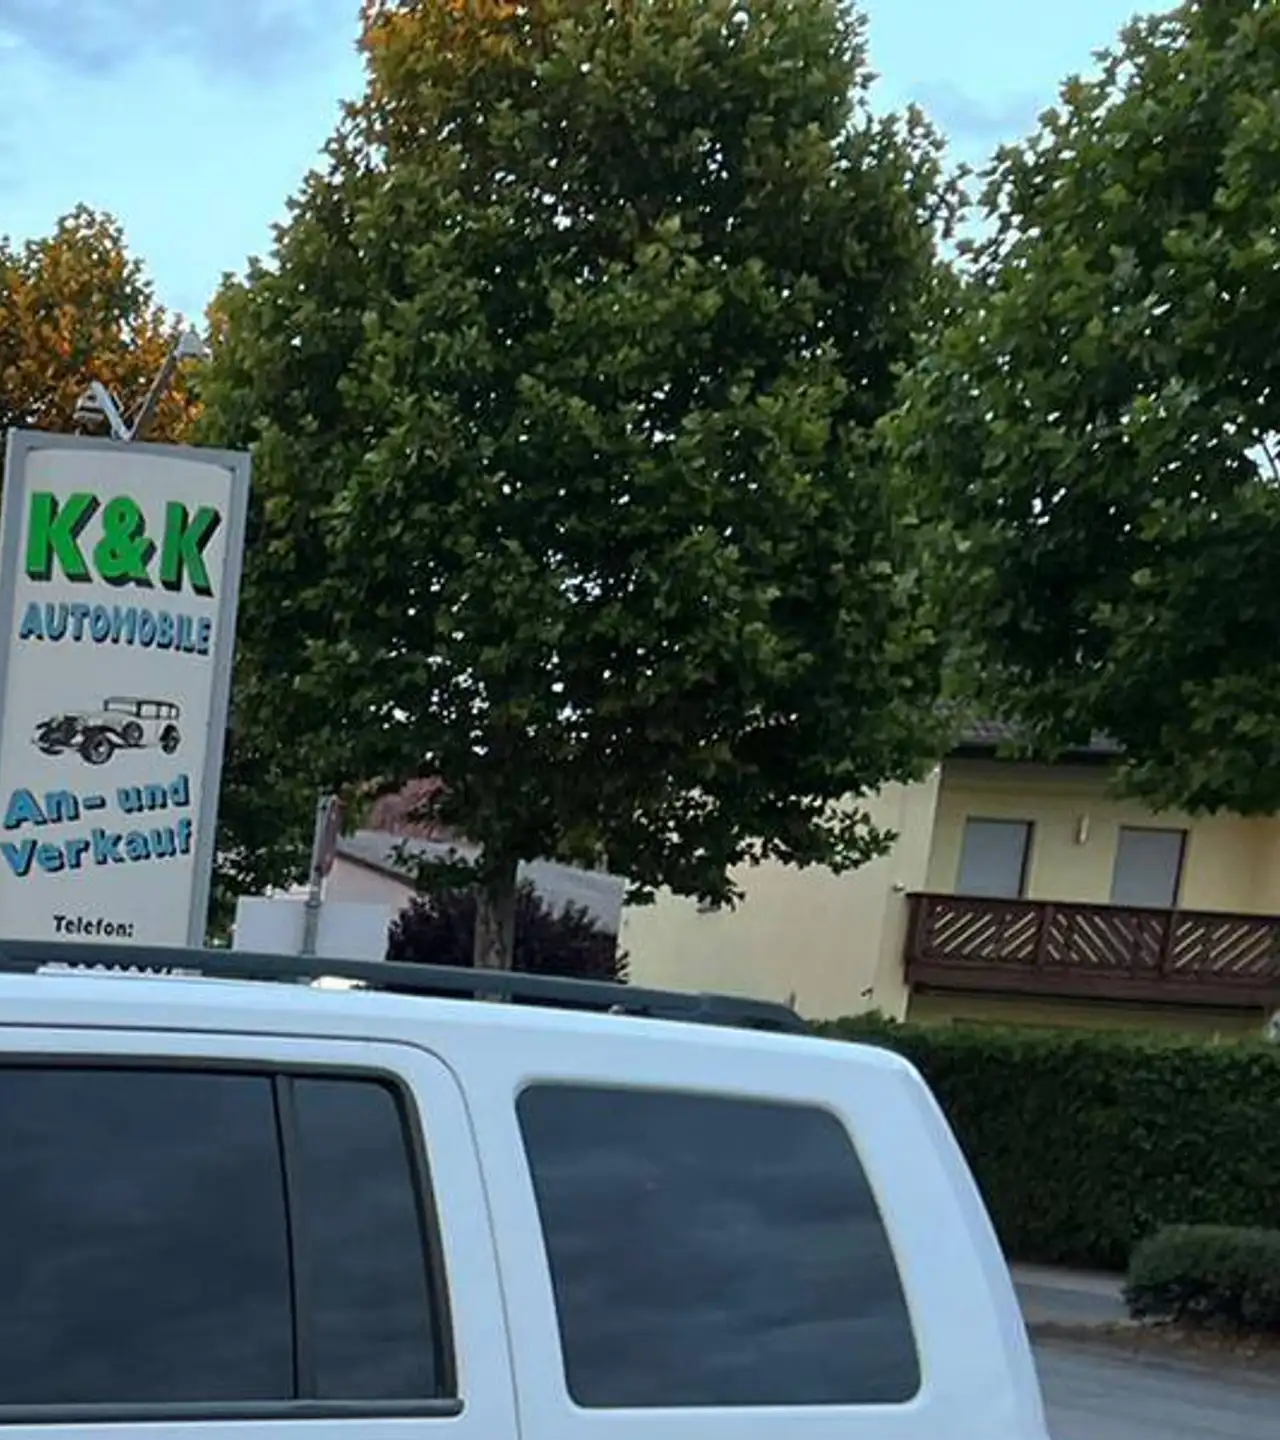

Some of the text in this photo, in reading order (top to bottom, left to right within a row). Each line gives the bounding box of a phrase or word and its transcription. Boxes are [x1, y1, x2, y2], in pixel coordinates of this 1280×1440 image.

[26, 492, 221, 595] K&K
[19, 603, 211, 656] AUTOMOBILE
[2, 774, 190, 830] An- und
[0, 818, 192, 878] Verkauf
[53, 915, 134, 938] Telefon:
